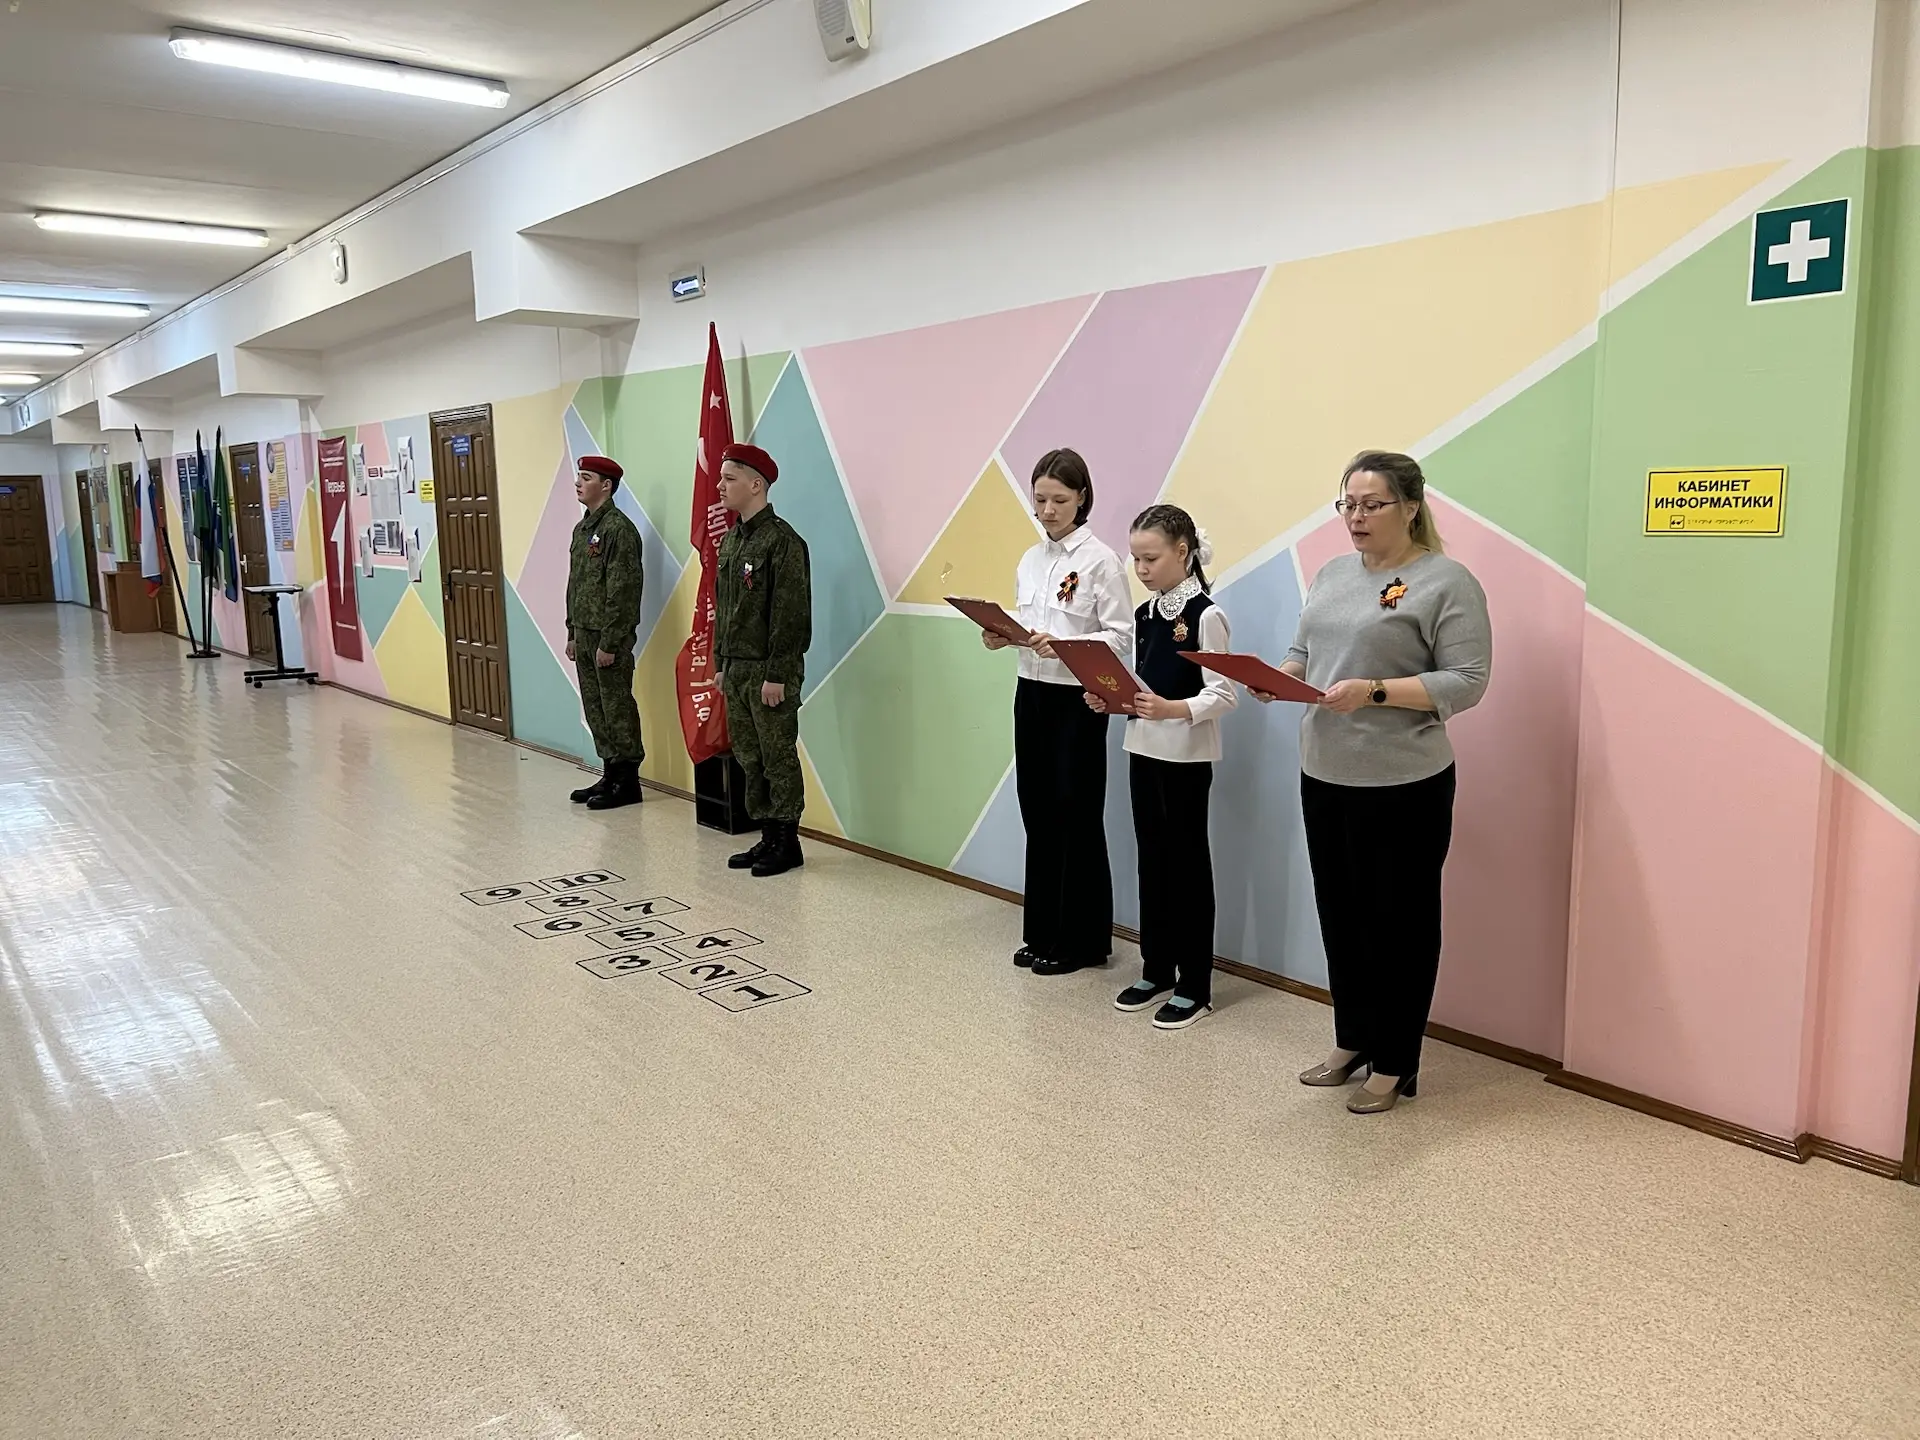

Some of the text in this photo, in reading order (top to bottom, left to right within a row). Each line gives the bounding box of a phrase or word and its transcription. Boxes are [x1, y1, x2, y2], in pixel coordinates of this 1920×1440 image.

[1678, 479, 1751, 493] КАБИНЕТ
[1654, 495, 1774, 509] ИНФОРМАТИКИ
[551, 873, 609, 888] 10
[486, 887, 522, 900] 9
[552, 896, 590, 908] 8
[623, 901, 655, 916] 7
[544, 917, 582, 931] 6
[614, 927, 656, 942] 5
[696, 936, 733, 949] 4
[608, 954, 651, 970] 3
[690, 964, 737, 982] 2
[733, 985, 779, 1002] 1
